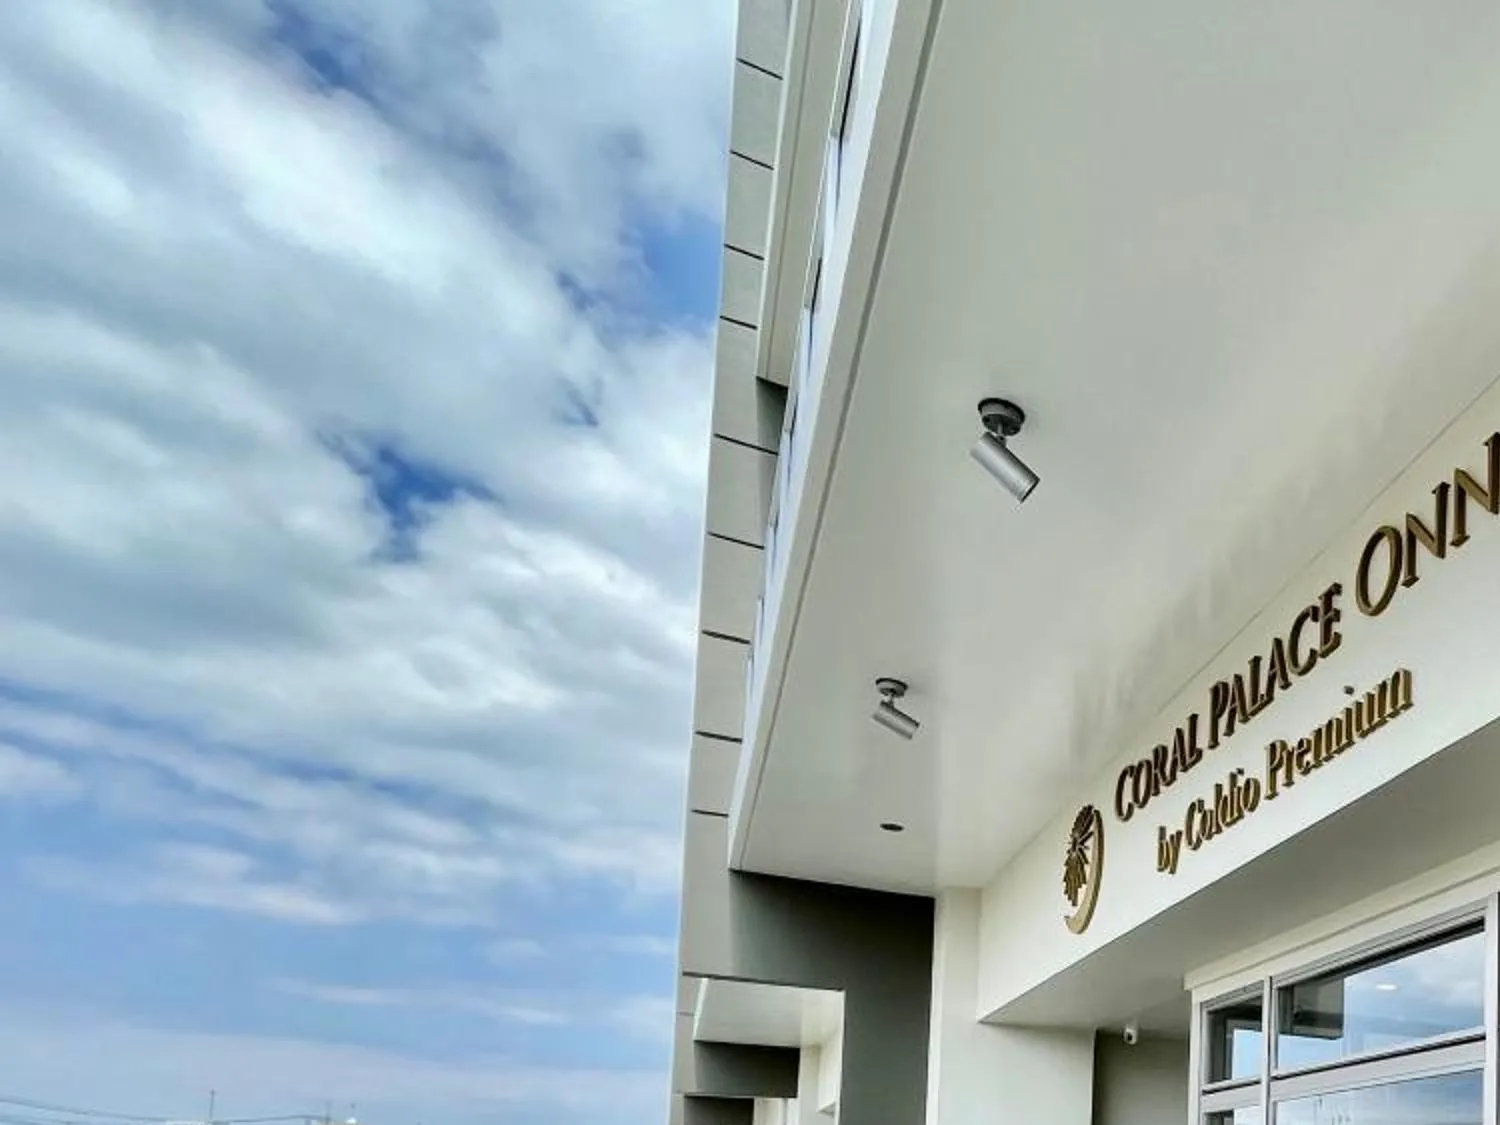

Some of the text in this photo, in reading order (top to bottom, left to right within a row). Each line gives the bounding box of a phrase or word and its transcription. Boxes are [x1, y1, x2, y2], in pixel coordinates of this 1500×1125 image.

[1114, 713, 1203, 822] CORAL
[1207, 582, 1343, 750] PALACE
[1157, 668, 1415, 874] by Caldio Premium
